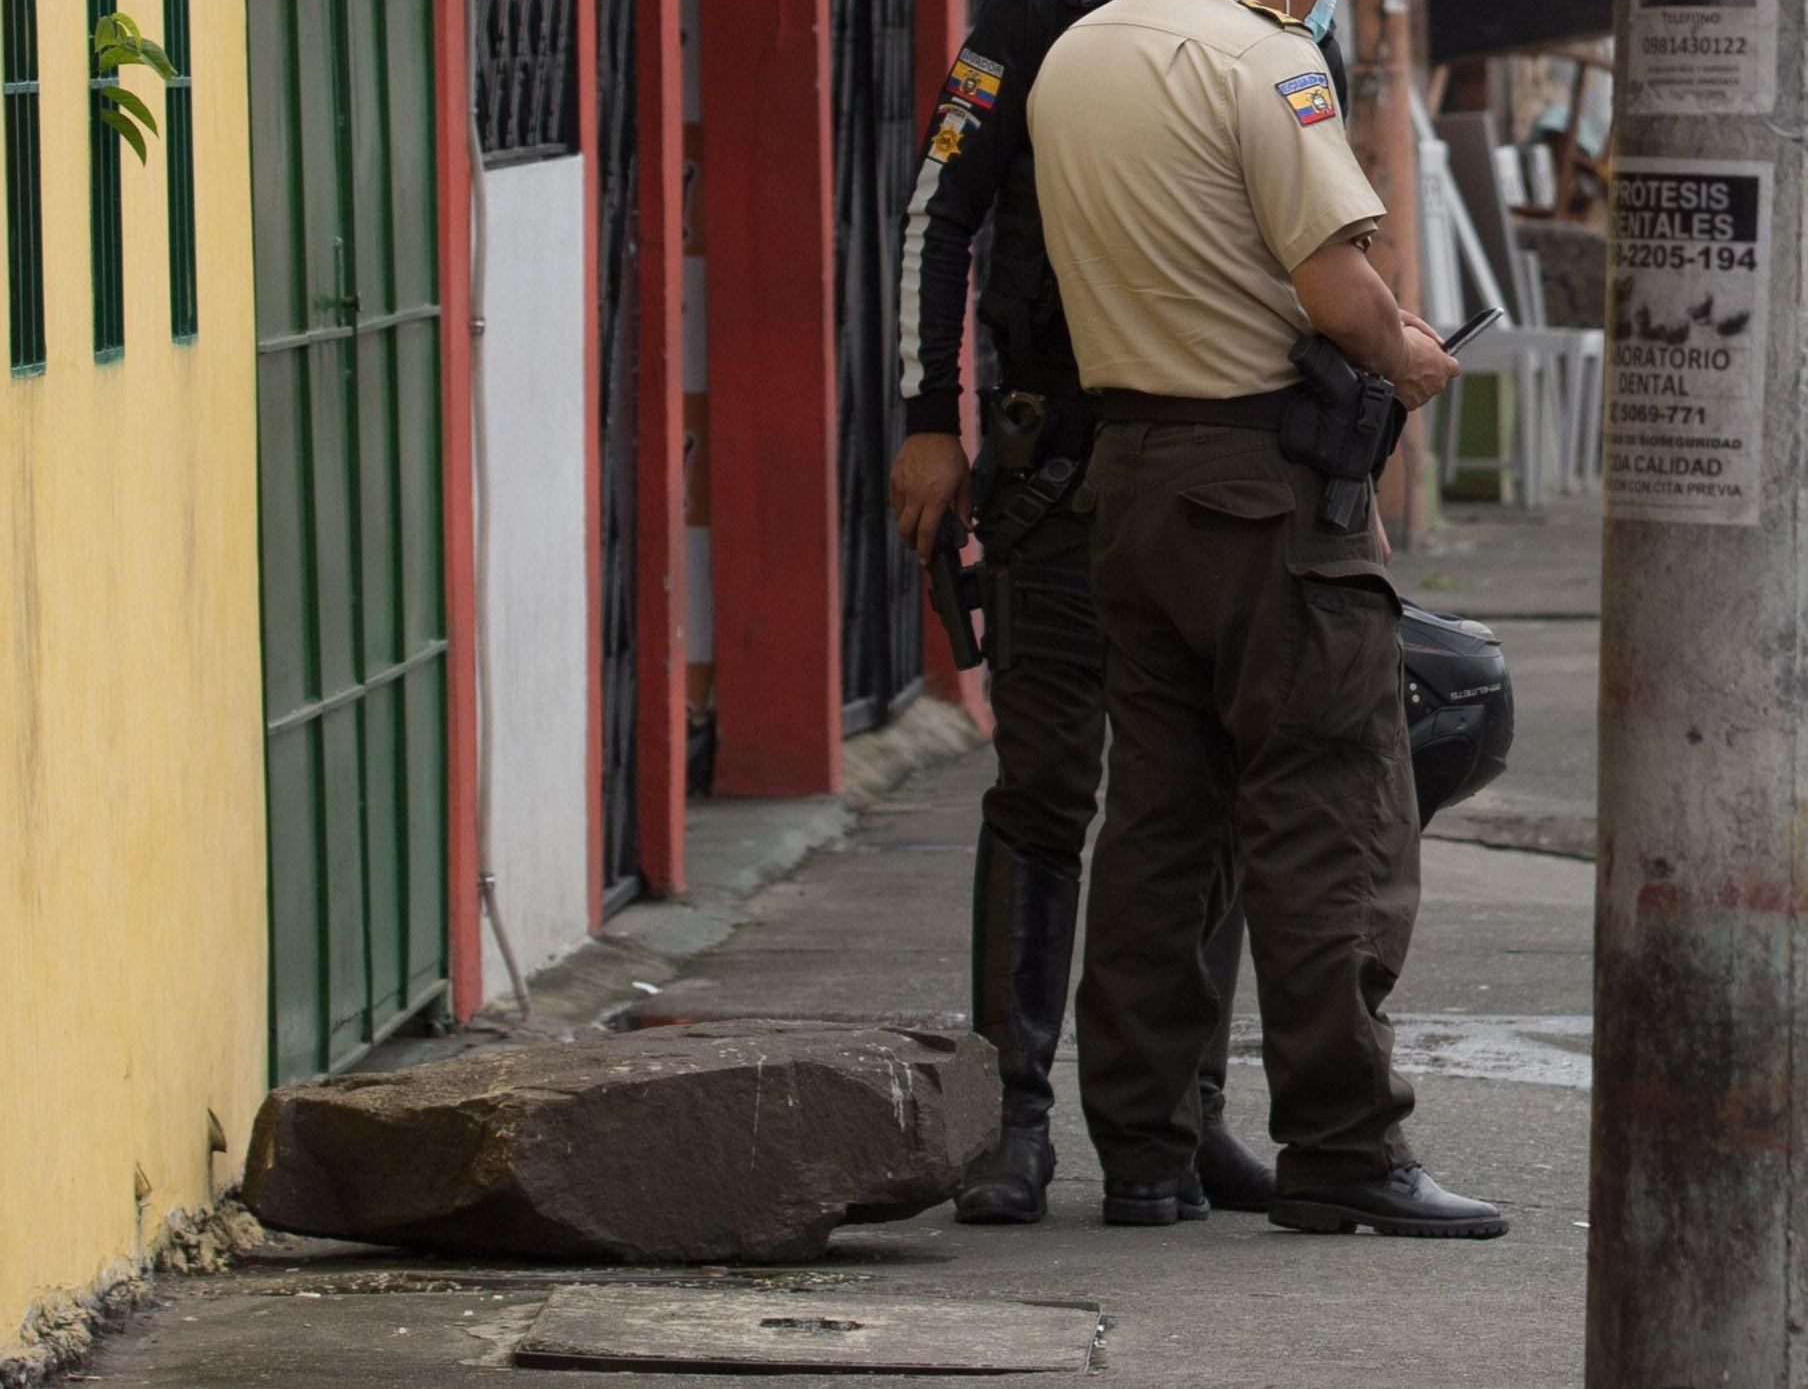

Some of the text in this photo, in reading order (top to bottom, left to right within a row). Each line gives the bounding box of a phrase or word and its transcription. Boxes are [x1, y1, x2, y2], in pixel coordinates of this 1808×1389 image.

[1618, 372, 1689, 397] DENTAL
[1633, 454, 1723, 477] CALIDAD
[1687, 481, 1742, 497] PREVIA
